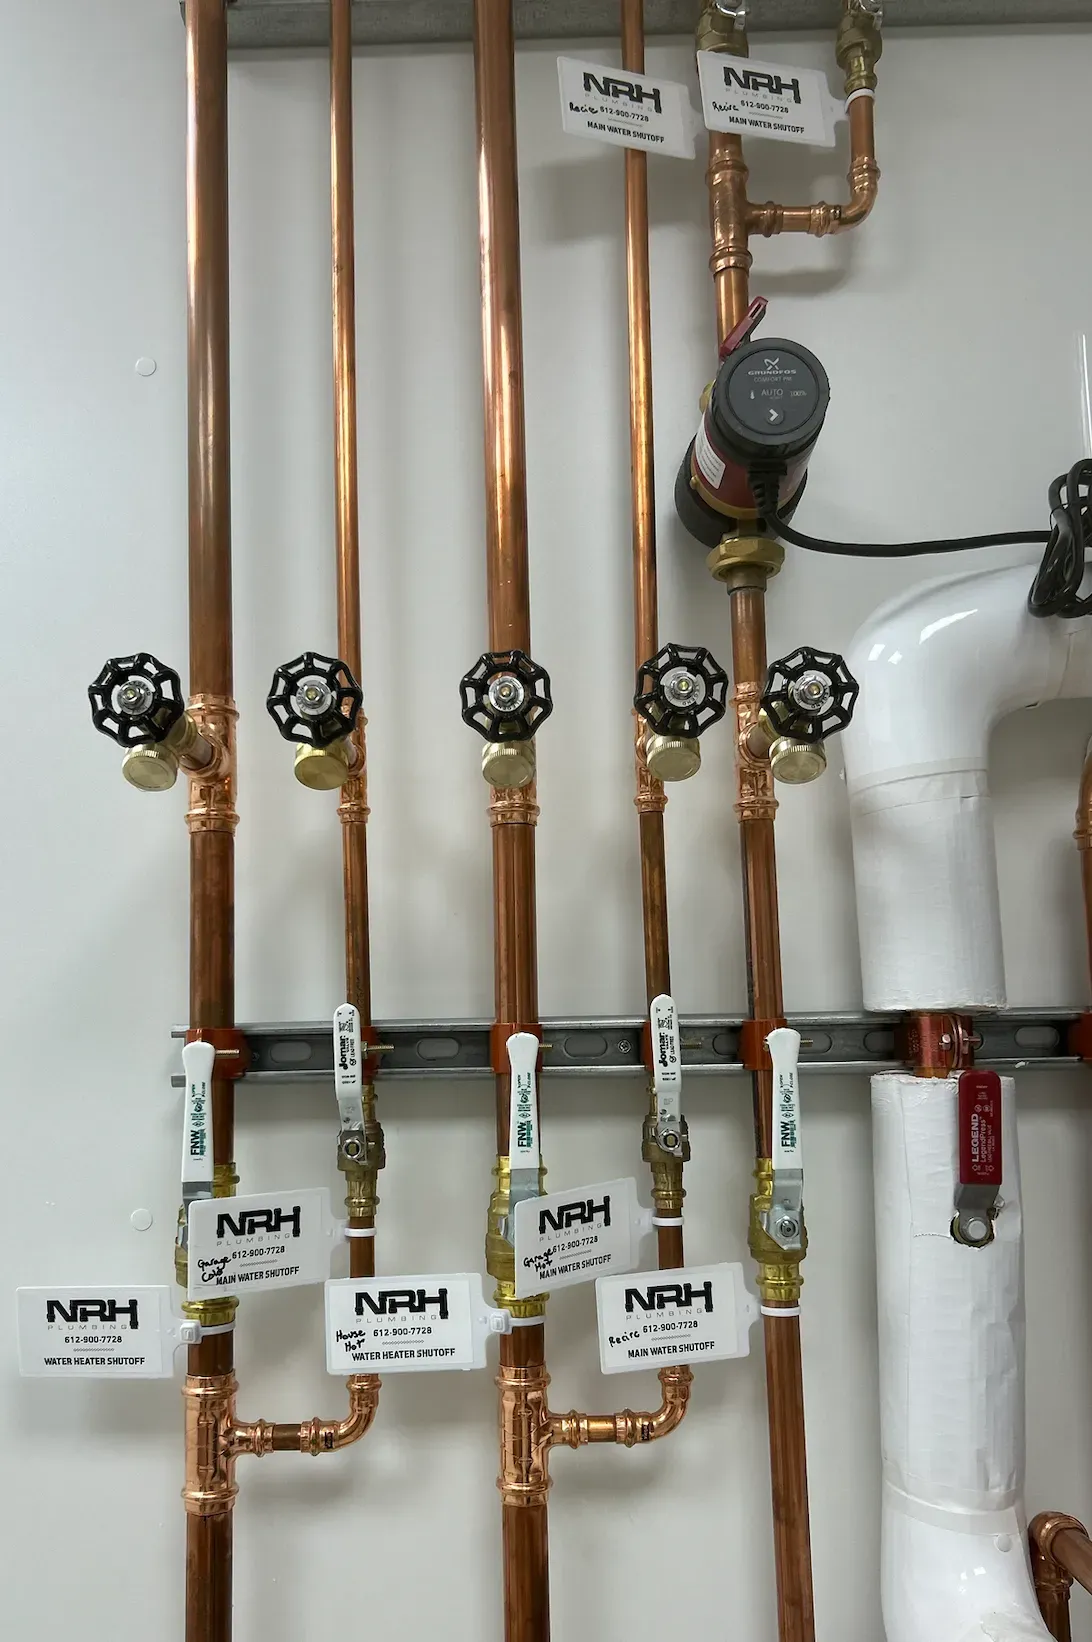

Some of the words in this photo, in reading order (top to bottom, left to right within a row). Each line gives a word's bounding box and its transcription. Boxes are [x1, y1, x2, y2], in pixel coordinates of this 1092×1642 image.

[583, 72, 661, 114] NRH
[723, 66, 801, 104] NRH
[600, 106, 649, 122] 612-900-7728
[741, 100, 788, 113] 612-900-7728
[588, 121, 606, 132] MAIN
[607, 125, 631, 137] WATER
[633, 131, 664, 143] SHUTOFF
[729, 116, 747, 125] MAIN
[748, 119, 772, 129] WATER
[773, 123, 804, 134] SHUTOFF
[191, 1130, 199, 1155] FNW
[518, 1123, 526, 1147] FNW
[780, 1121, 790, 1147] FNW
[216, 1206, 300, 1238] NRH
[539, 1196, 610, 1234] NRH
[217, 1233, 290, 1246] PLUMBING
[540, 1223, 602, 1242] PLUMBING
[232, 1246, 285, 1259] 612-900-7728
[553, 1236, 598, 1252] 612-900-7728
[198, 1256, 231, 1272] Garage
[524, 1248, 553, 1267] Garage
[540, 1267, 557, 1279] MAIN
[558, 1262, 580, 1274] WATER
[582, 1254, 611, 1268] SHUTOFF
[216, 1274, 236, 1285] MAIN
[238, 1271, 264, 1282] WATER
[266, 1266, 299, 1279] SHUTOFF
[355, 1288, 448, 1319] NRH
[625, 1281, 713, 1312] NRH
[46, 1299, 138, 1329] NRH
[356, 1315, 436, 1324] PLUMBING
[626, 1308, 702, 1320] PLUMBING
[373, 1327, 432, 1336] 612-900-7728
[643, 1320, 698, 1334] 612-900-7728
[352, 1351, 381, 1361] WATER
[382, 1350, 414, 1360] HEATER
[417, 1348, 455, 1358] SHUTOFF
[628, 1348, 648, 1358] MAIN
[650, 1345, 677, 1356] WATER
[679, 1341, 715, 1353] SHUTOFF
